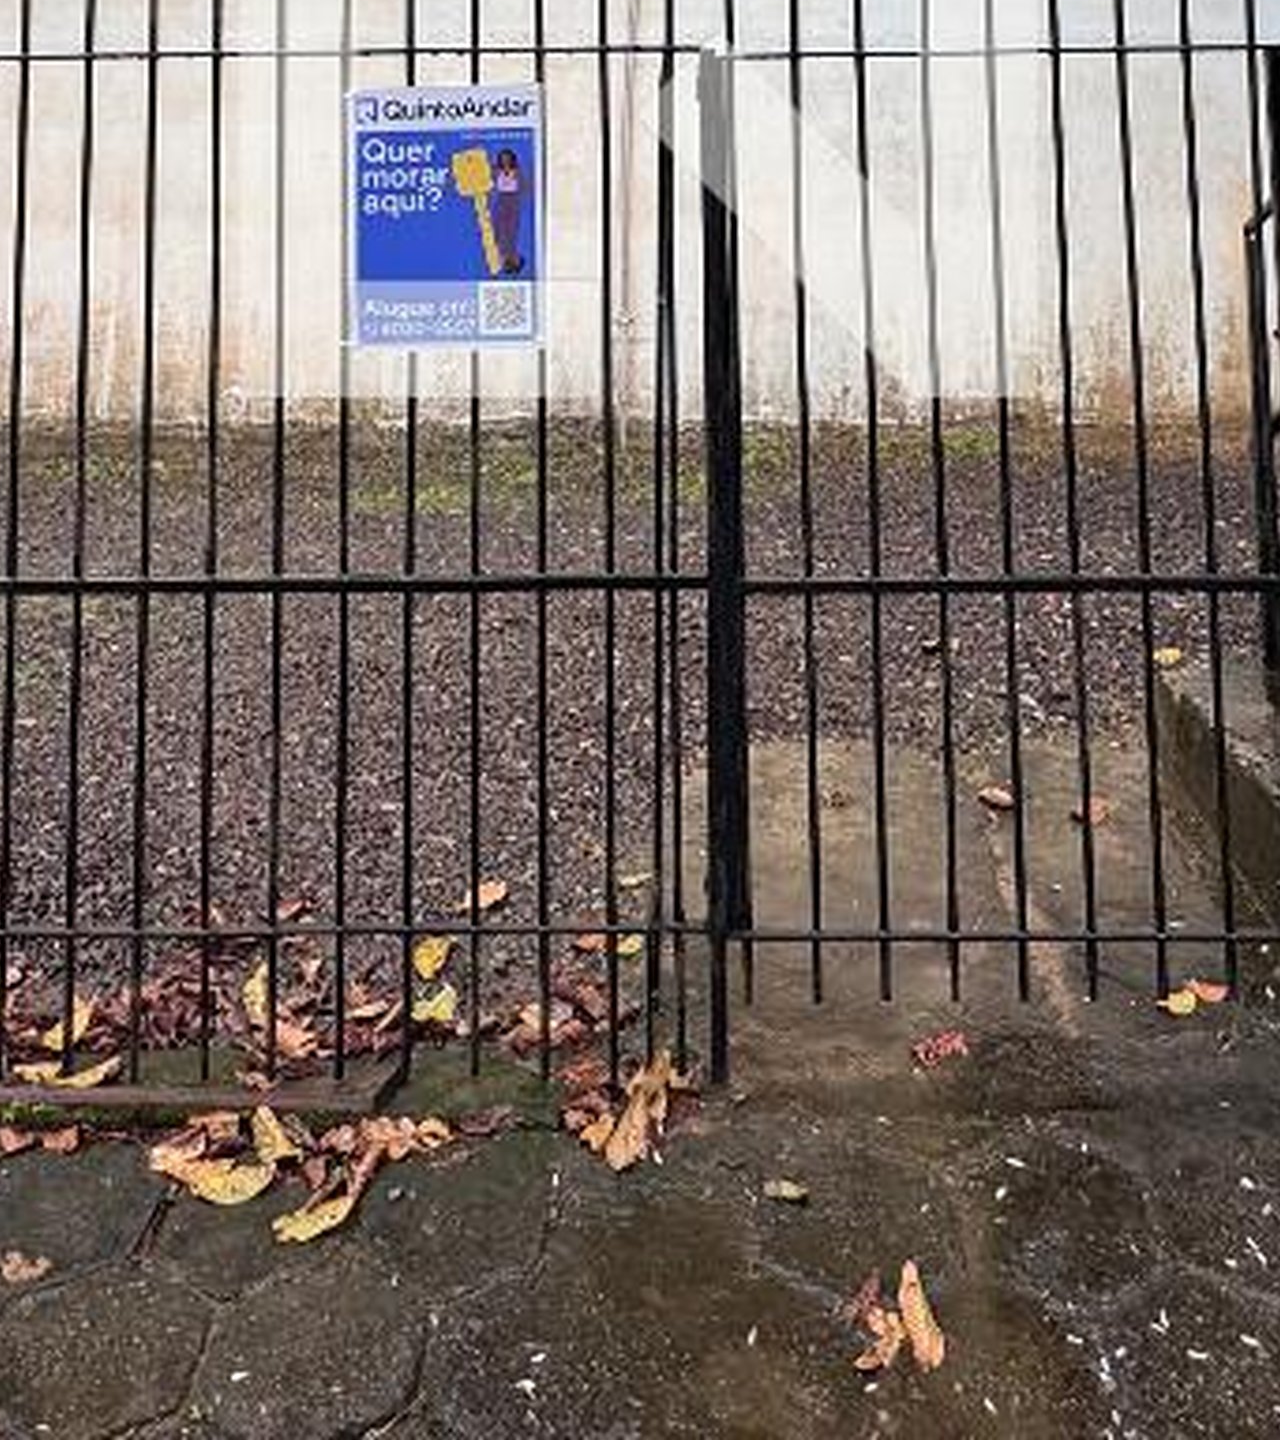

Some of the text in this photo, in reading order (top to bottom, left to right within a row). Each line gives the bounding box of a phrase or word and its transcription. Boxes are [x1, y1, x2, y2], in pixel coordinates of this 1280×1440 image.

[382, 96, 535, 122] QuintoAndar
[362, 138, 435, 166] Quer
[362, 166, 449, 189] morar
[363, 187, 443, 218] aqui?
